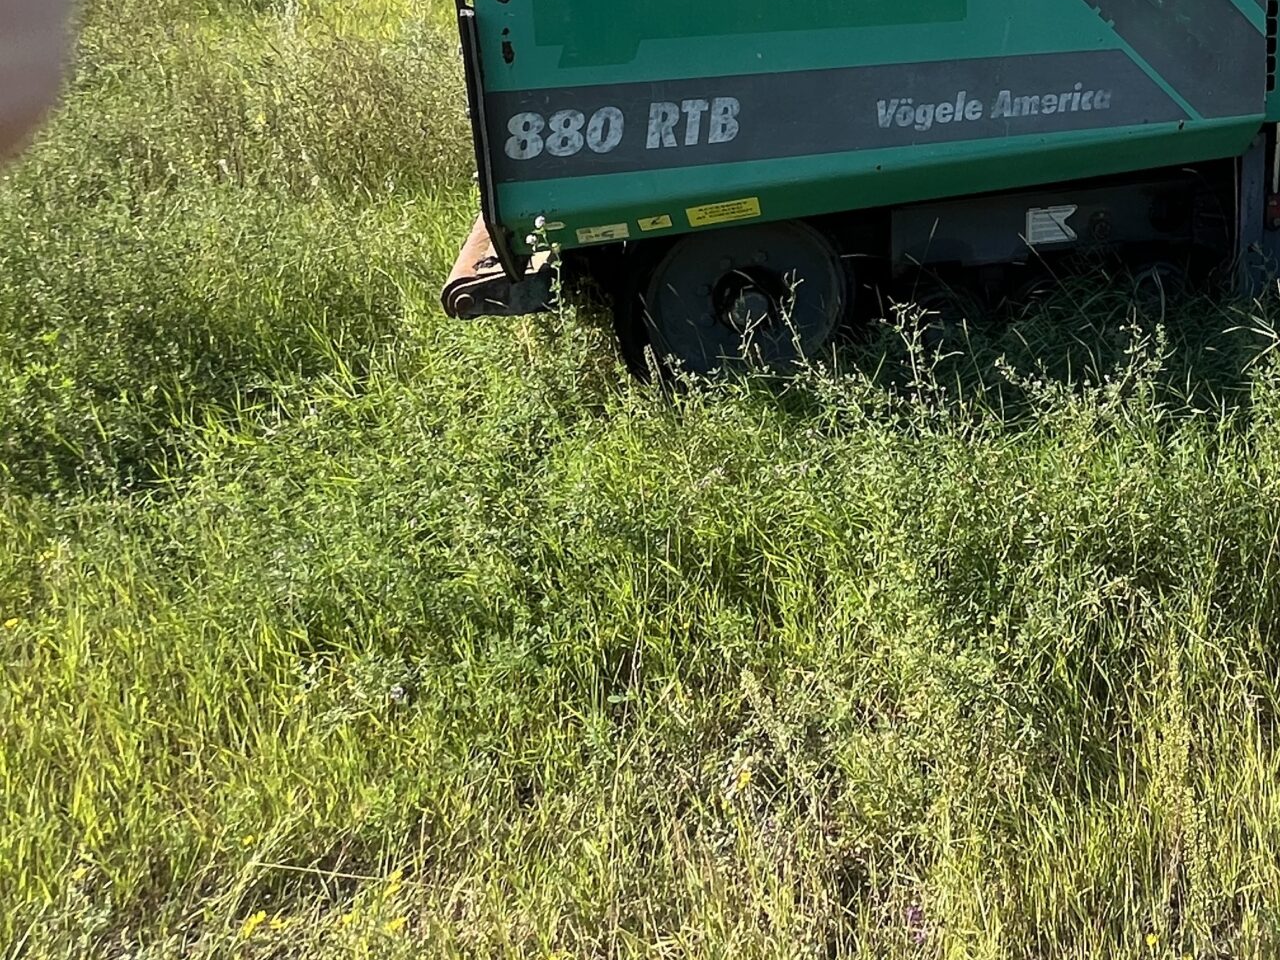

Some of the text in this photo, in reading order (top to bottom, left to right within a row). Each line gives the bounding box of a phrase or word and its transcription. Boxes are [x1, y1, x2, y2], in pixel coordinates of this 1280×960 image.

[504, 97, 741, 160] 880 RTB
[876, 82, 1112, 131] Vögele America
